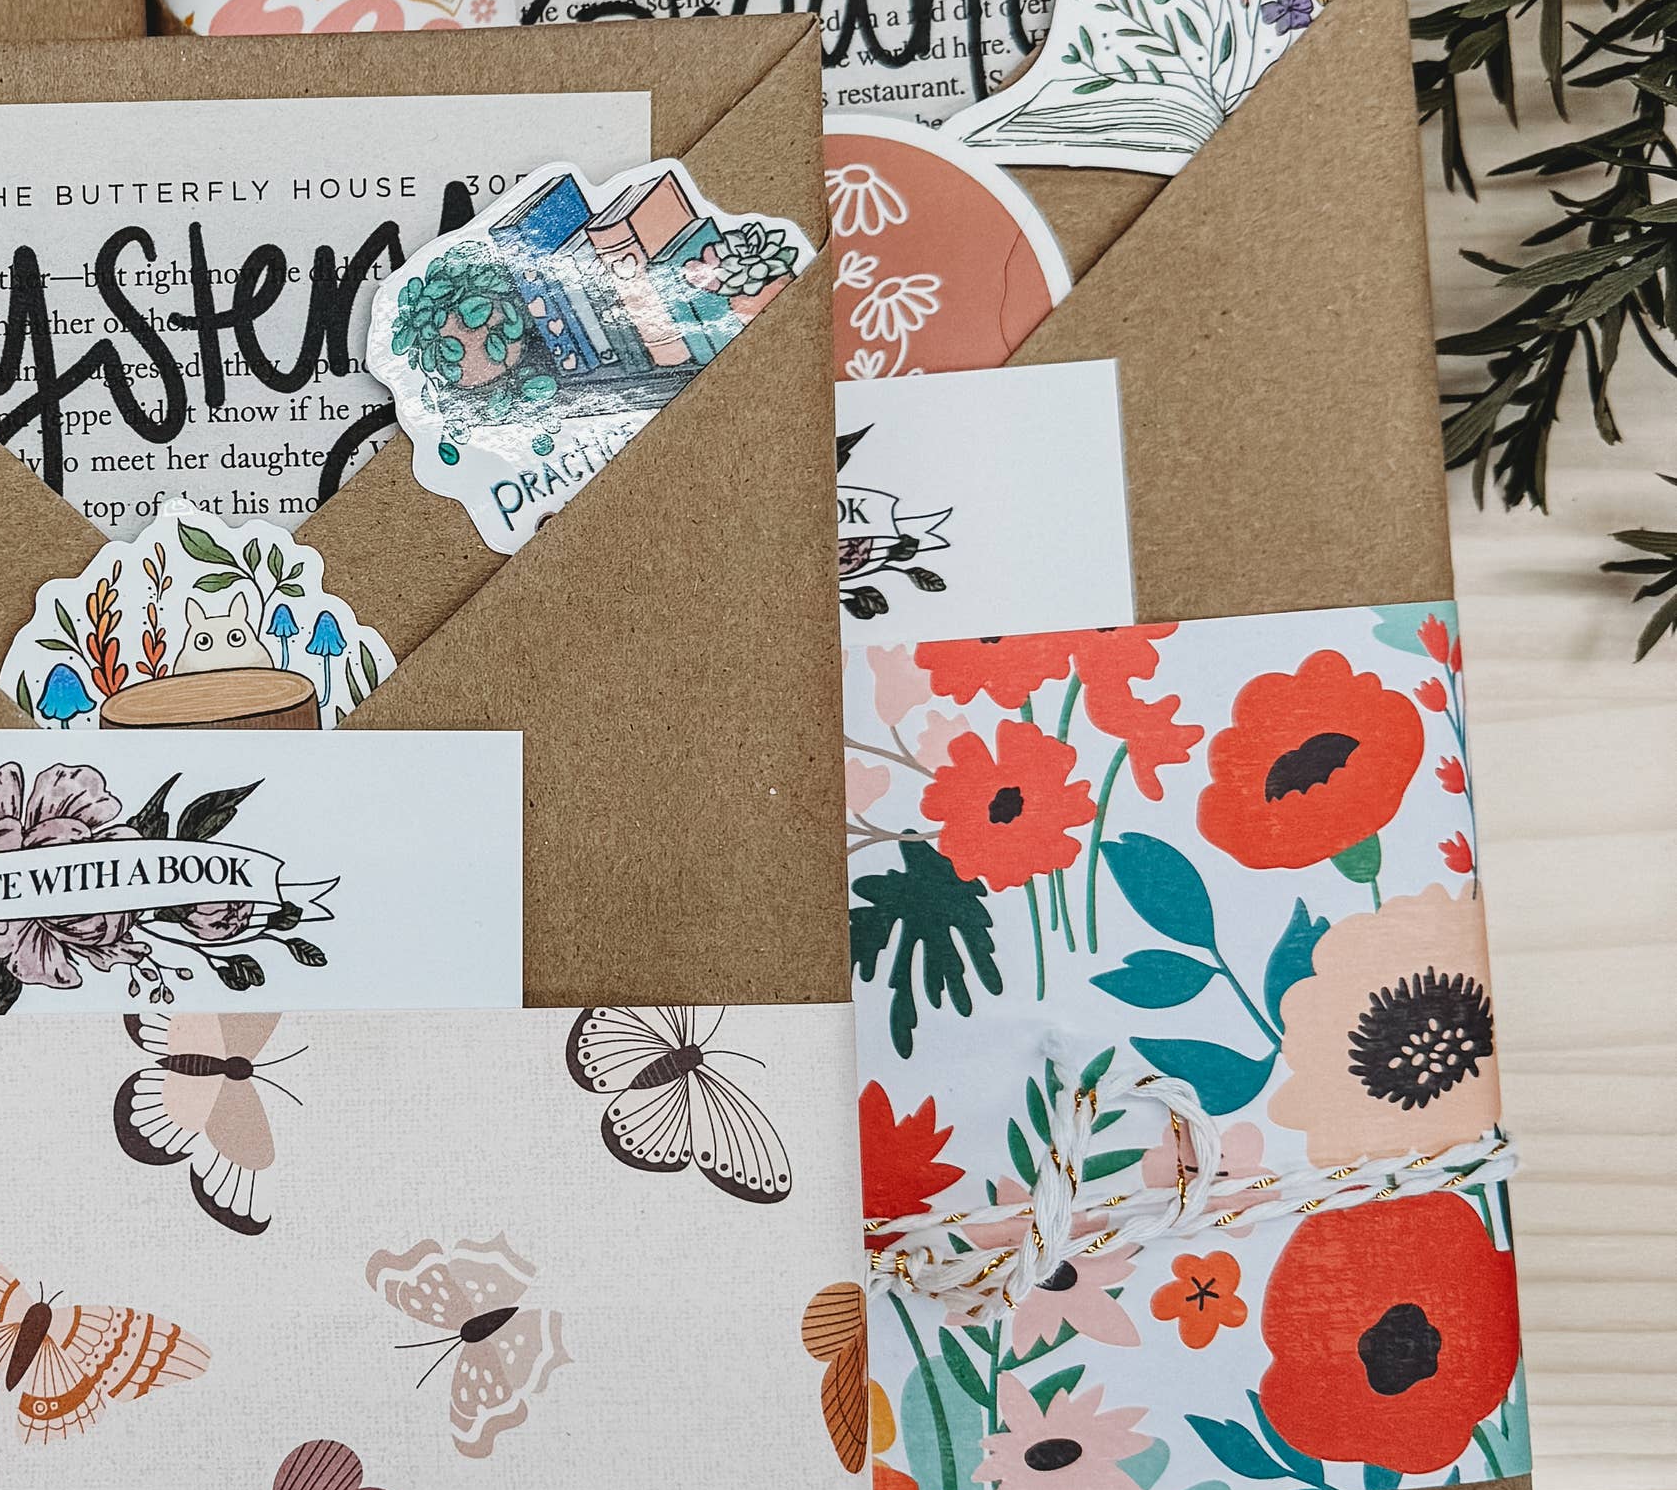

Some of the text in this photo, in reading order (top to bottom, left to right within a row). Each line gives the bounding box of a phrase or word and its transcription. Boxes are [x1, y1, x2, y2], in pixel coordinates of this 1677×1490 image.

[838, 76, 966, 106] restaurant.
[56, 179, 269, 206] BUTTERFLY
[293, 176, 416, 200] HOUSE
[207, 403, 281, 424] know
[289, 395, 313, 421] if
[319, 395, 350, 421] he
[91, 451, 155, 472] meet
[167, 444, 209, 470] her
[83, 498, 125, 526] top
[135, 490, 165, 517] of
[232, 489, 269, 514] his
[30, 859, 119, 899] WITH
[127, 858, 148, 888] A
[158, 855, 254, 889] BOOK
